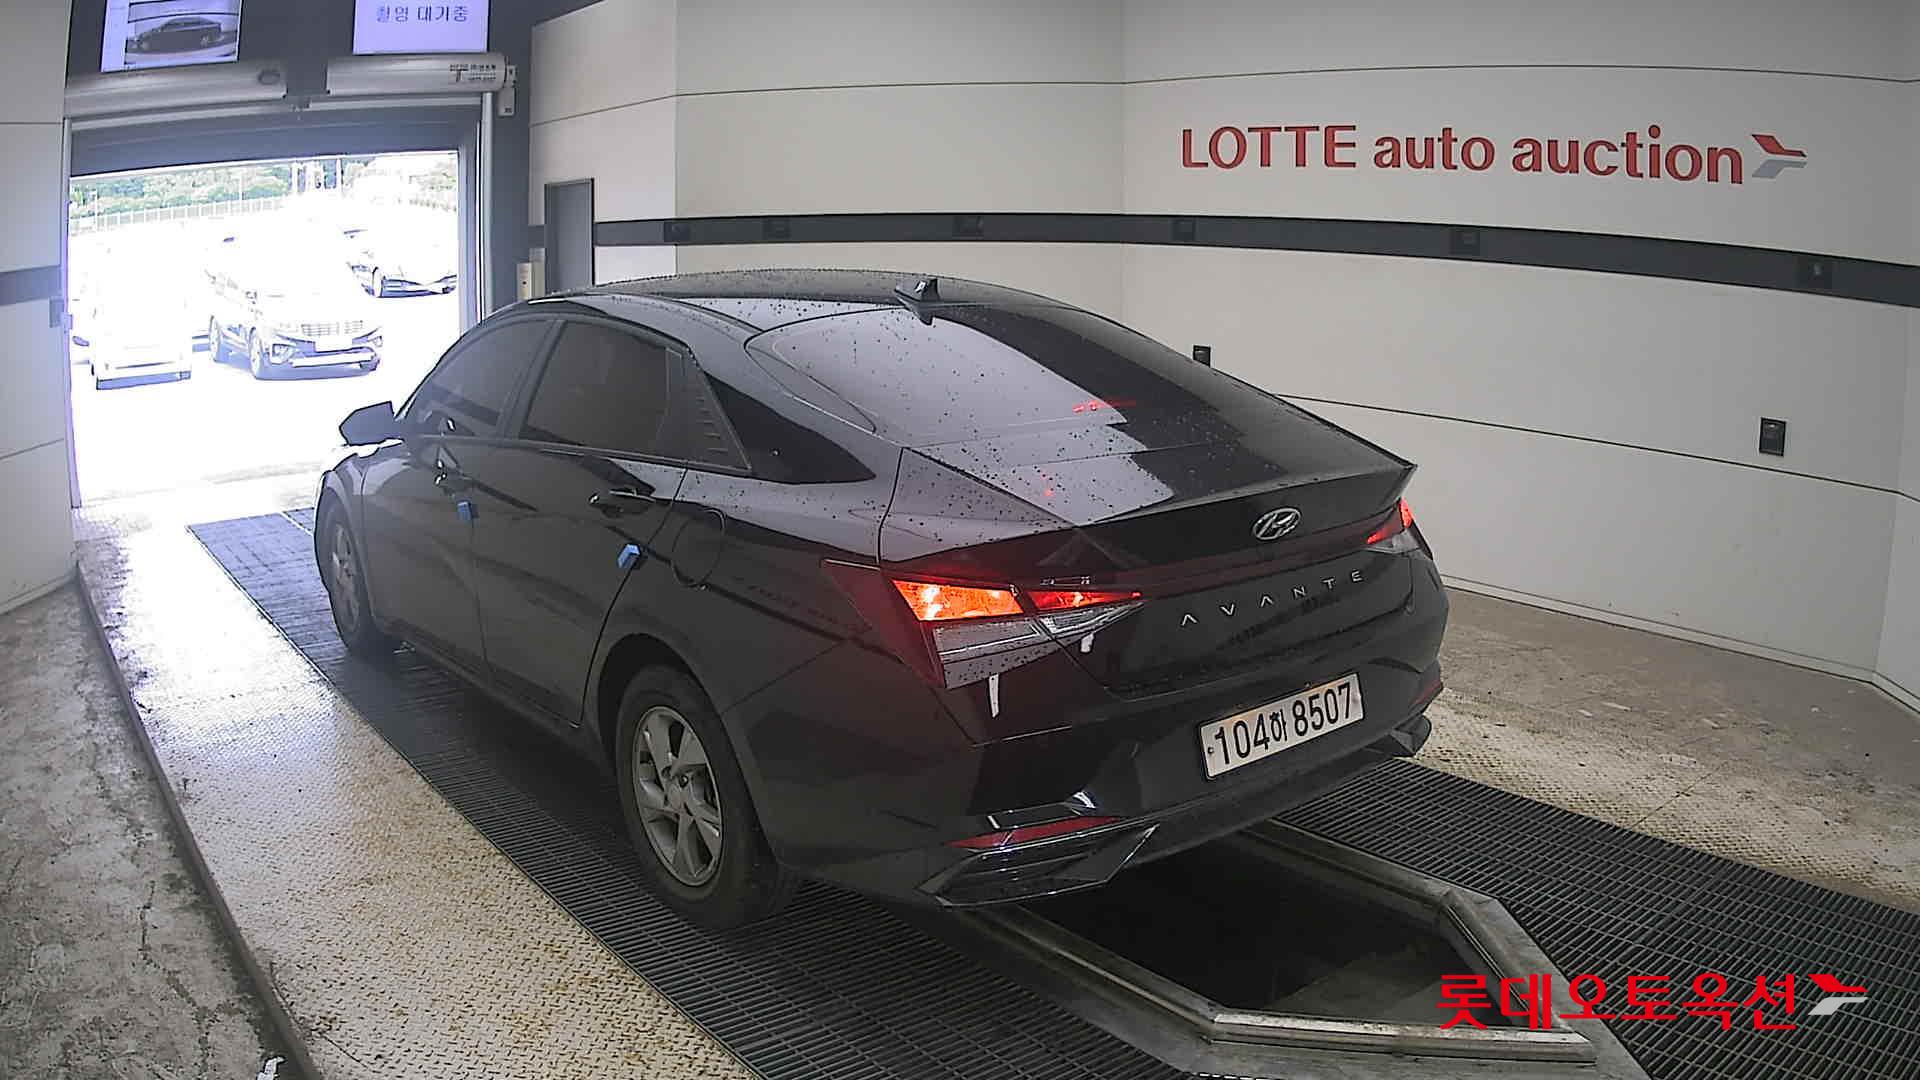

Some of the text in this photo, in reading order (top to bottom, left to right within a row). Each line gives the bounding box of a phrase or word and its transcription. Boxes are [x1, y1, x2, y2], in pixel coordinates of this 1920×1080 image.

[417, 5, 469, 22] 대기중
[1182, 124, 1743, 183] LOTTE auto auction
[1181, 570, 1363, 626] AVANTE
[1292, 683, 1352, 738] 8507
